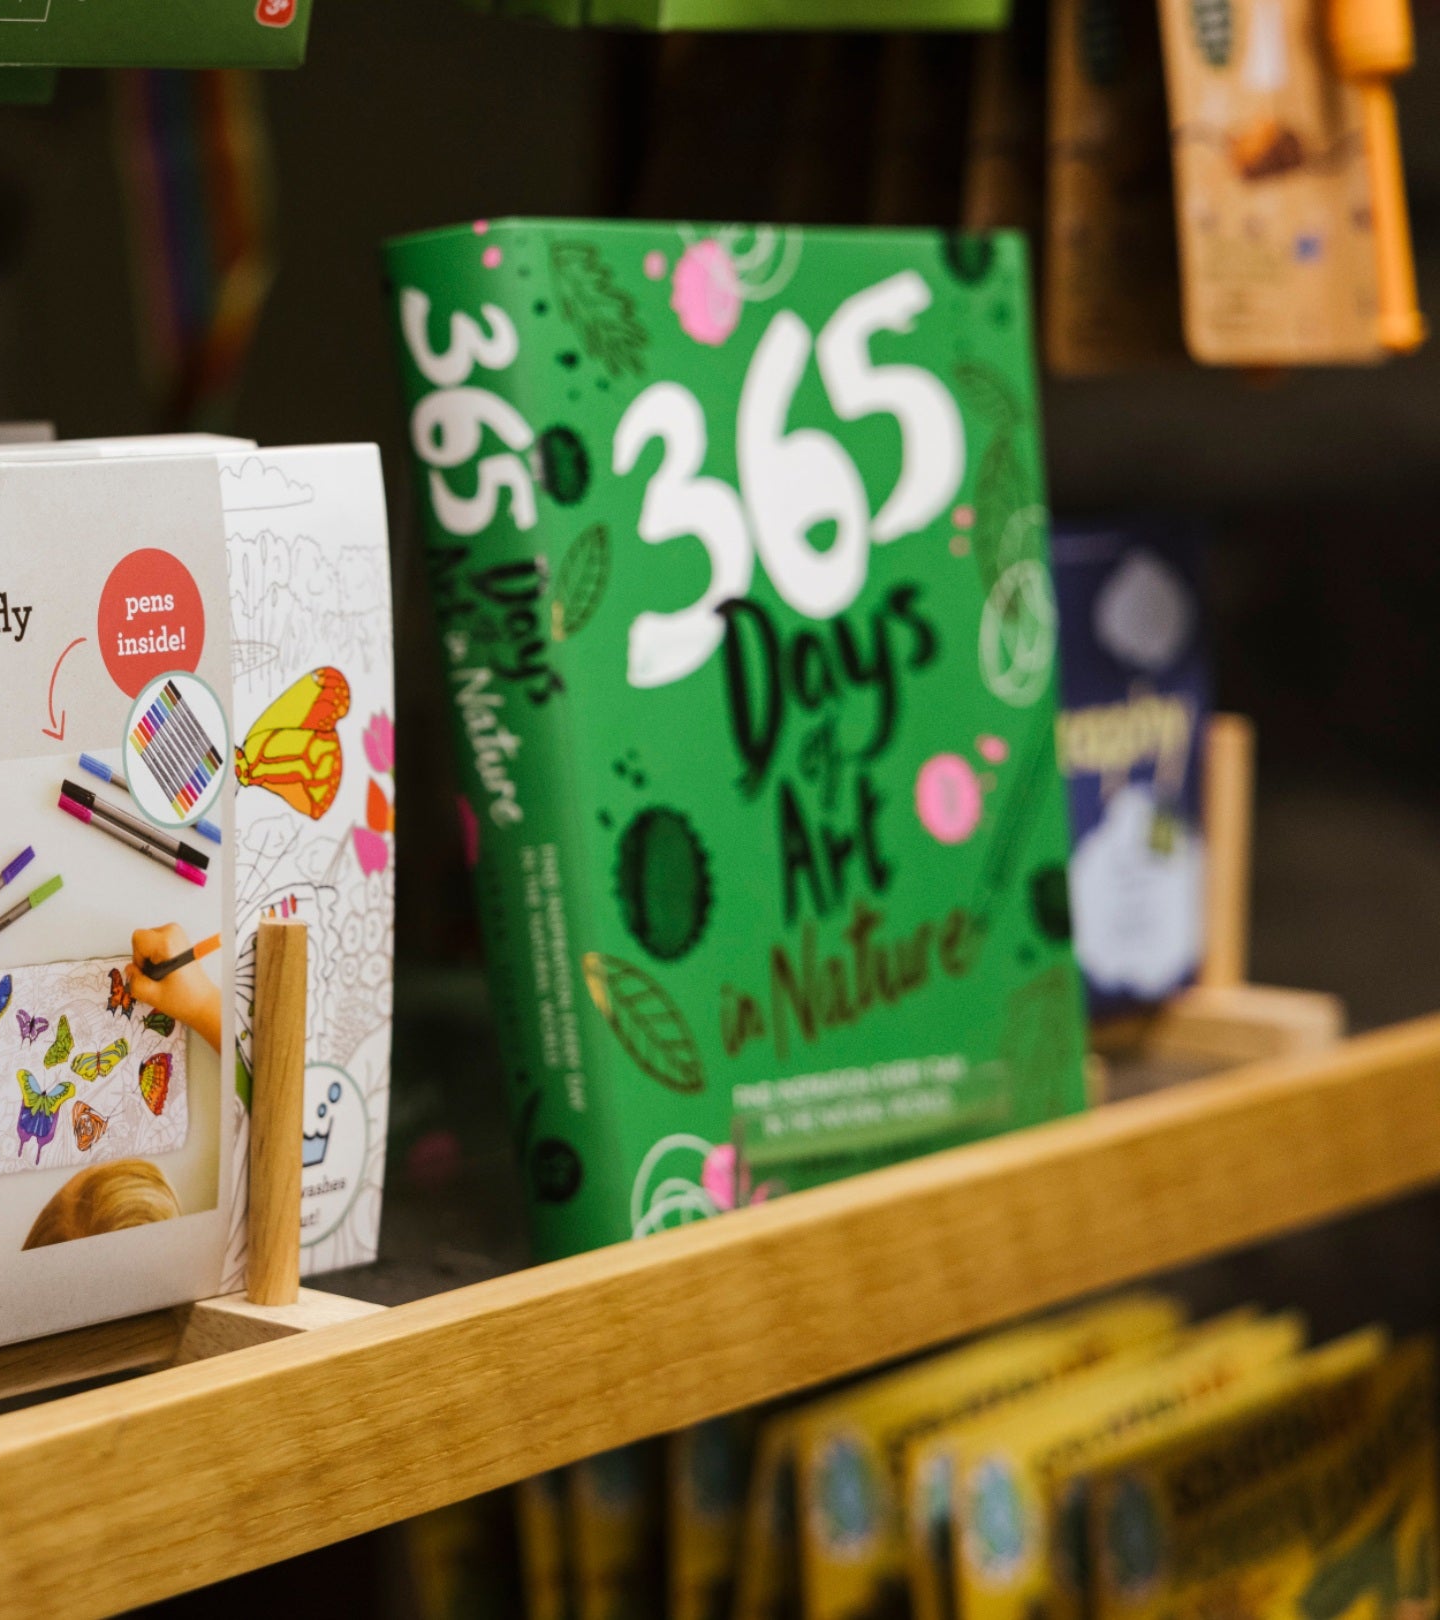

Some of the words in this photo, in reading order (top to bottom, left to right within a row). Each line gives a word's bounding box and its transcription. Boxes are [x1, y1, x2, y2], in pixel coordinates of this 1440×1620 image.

[400, 286, 538, 535] 365
[612, 269, 967, 689] 365
[117, 626, 187, 658] inside!
[125, 592, 176, 622] pens
[450, 665, 523, 829] Nature
[713, 584, 940, 803] Days
[777, 774, 896, 929] Art
[770, 898, 991, 1063] Nature
[301, 1174, 346, 1199] ashes
